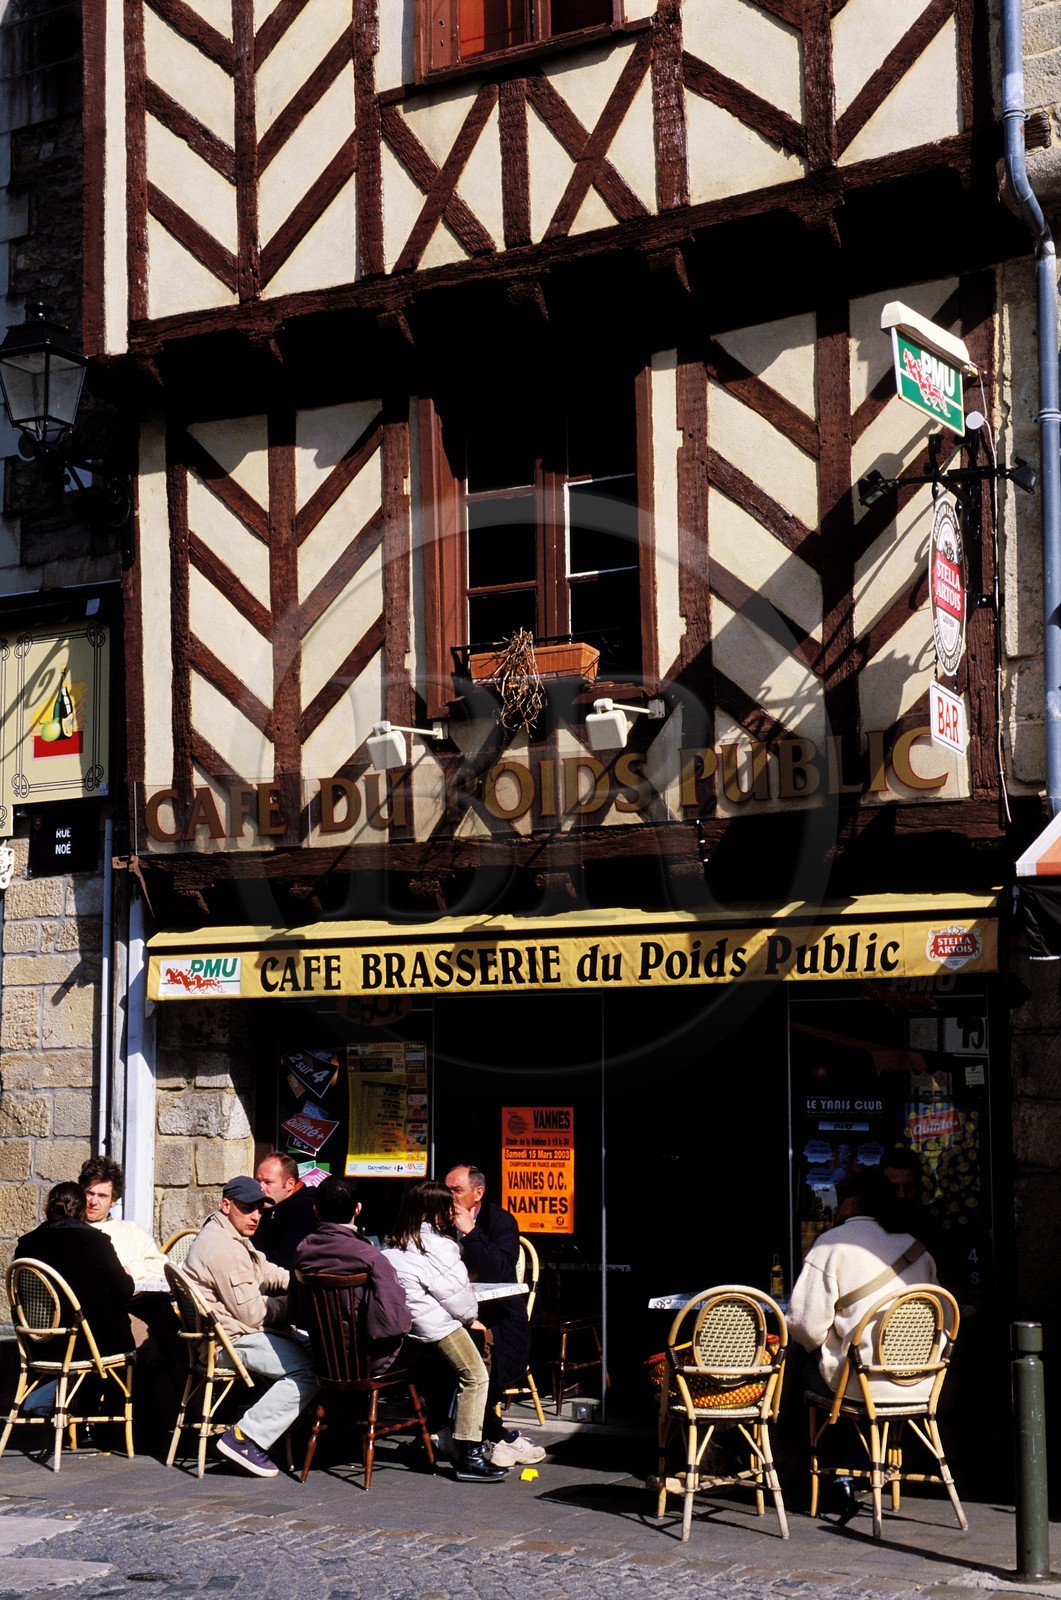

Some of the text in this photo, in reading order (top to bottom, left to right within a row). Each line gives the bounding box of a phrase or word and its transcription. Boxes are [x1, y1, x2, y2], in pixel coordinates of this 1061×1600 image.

[920, 350, 956, 397] PMU
[936, 561, 961, 592] STELLA
[936, 585, 962, 612] ARTOIS
[934, 695, 960, 743] BAR
[144, 726, 950, 843] CAFE DU POIDS PUBLIC
[55, 827, 72, 839] RUE
[55, 841, 72, 855] NOÉ
[936, 935, 972, 947] STELLA
[936, 944, 973, 955] ARTOIS
[190, 957, 239, 979] PMU
[259, 931, 901, 993] CAFE BRASSERIE du Poids Public
[288, 1053, 301, 1064] 2
[295, 1061, 314, 1076] sur
[312, 1066, 330, 1084] 4
[806, 1099, 817, 1109] LE
[854, 1099, 883, 1110] CLUB
[285, 1117, 325, 1140] Quinté+
[533, 1109, 571, 1130] VANNES
[912, 1116, 960, 1136] Quinté+
[505, 1136, 518, 1146] Stade
[519, 1137, 525, 1146] de
[526, 1137, 530, 1146] la
[552, 1137, 558, 1146] 19
[505, 1149, 570, 1159] Samedi 15 Mars 2003
[507, 1171, 567, 1191] VANNES O.C.
[507, 1195, 569, 1215] NANTES
